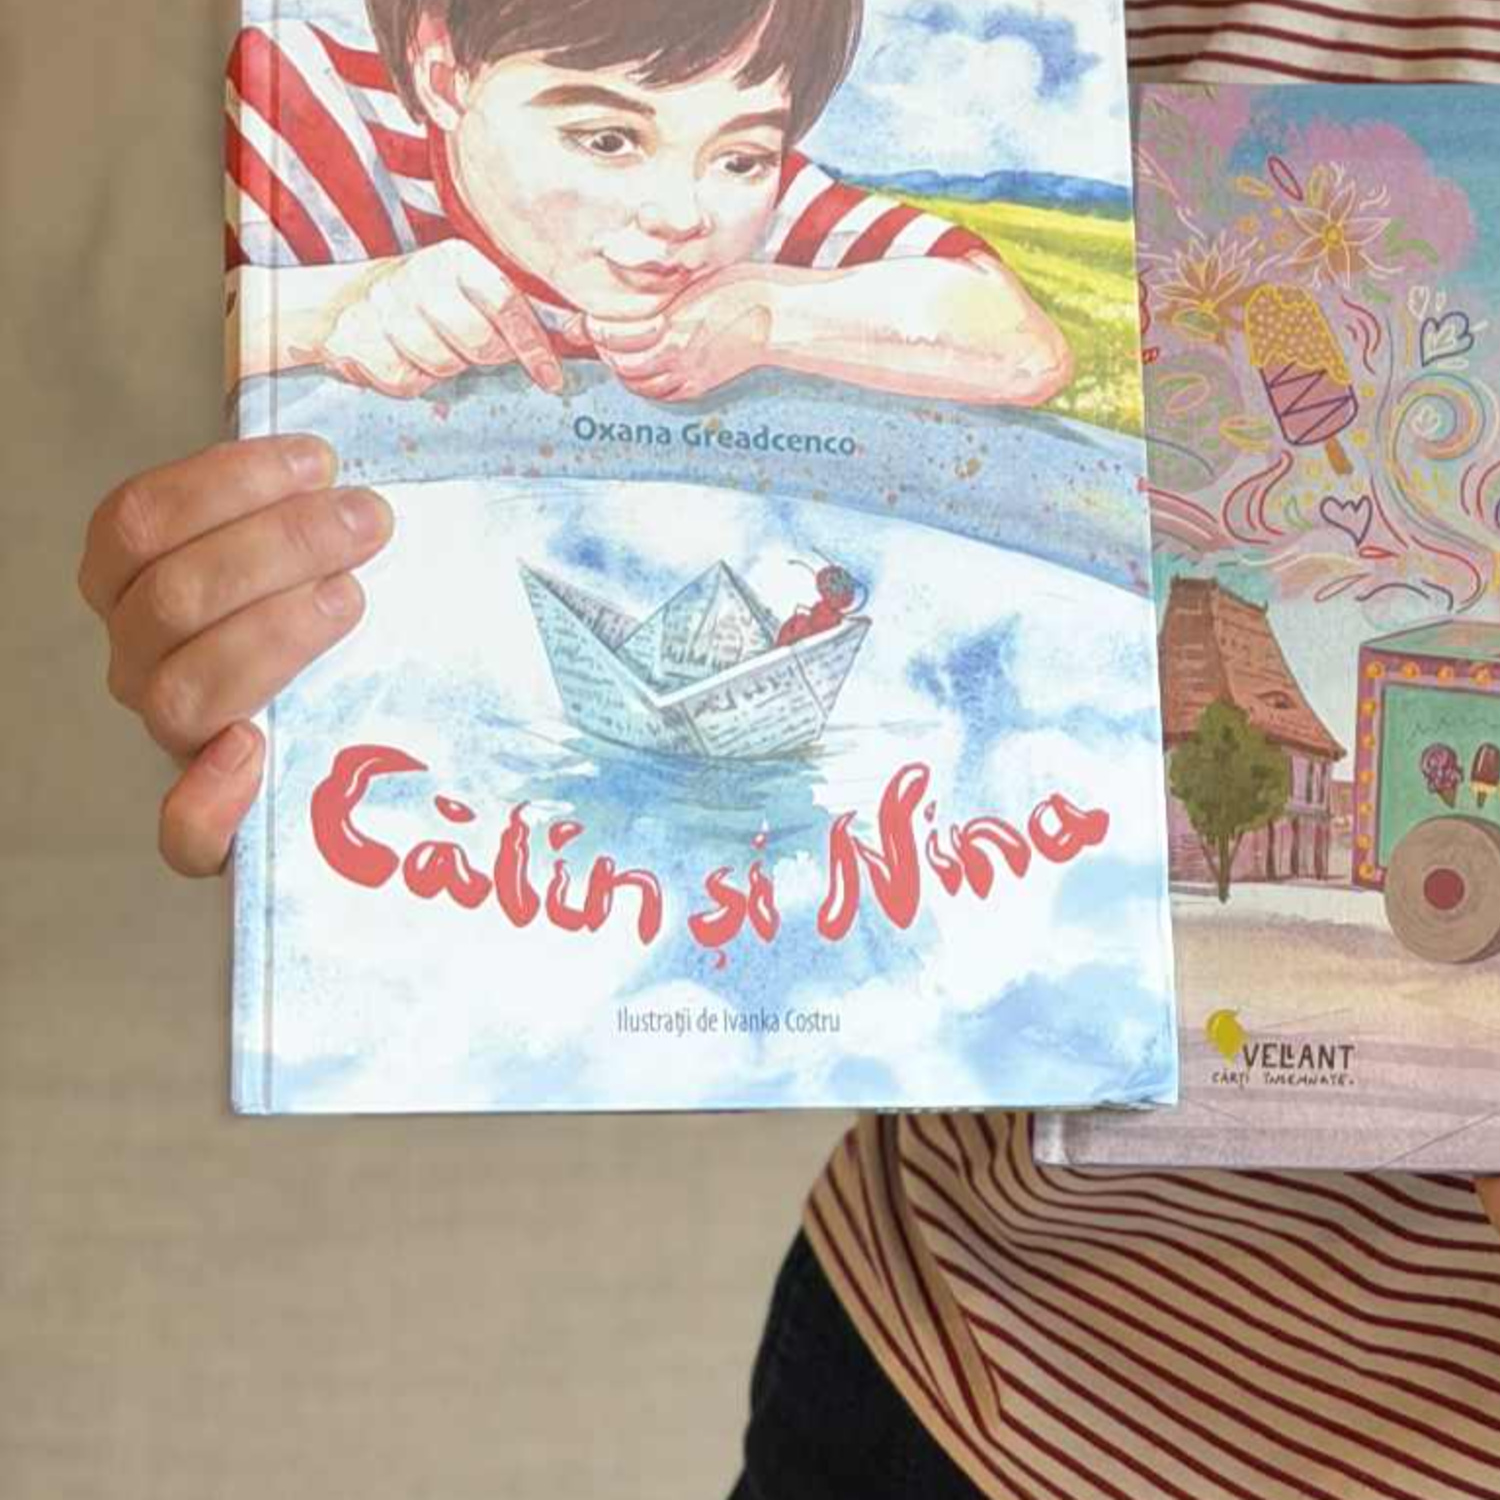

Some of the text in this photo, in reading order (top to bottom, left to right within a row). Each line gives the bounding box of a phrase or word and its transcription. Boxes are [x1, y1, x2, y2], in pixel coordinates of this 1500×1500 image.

[573, 415, 857, 455] Oxana Greadcenco
[816, 762, 1110, 942] Nina
[696, 1007, 718, 1032] de
[723, 1008, 780, 1033] Ivanka
[785, 1008, 841, 1033] Costru
[1242, 1042, 1356, 1070] VELLANT
